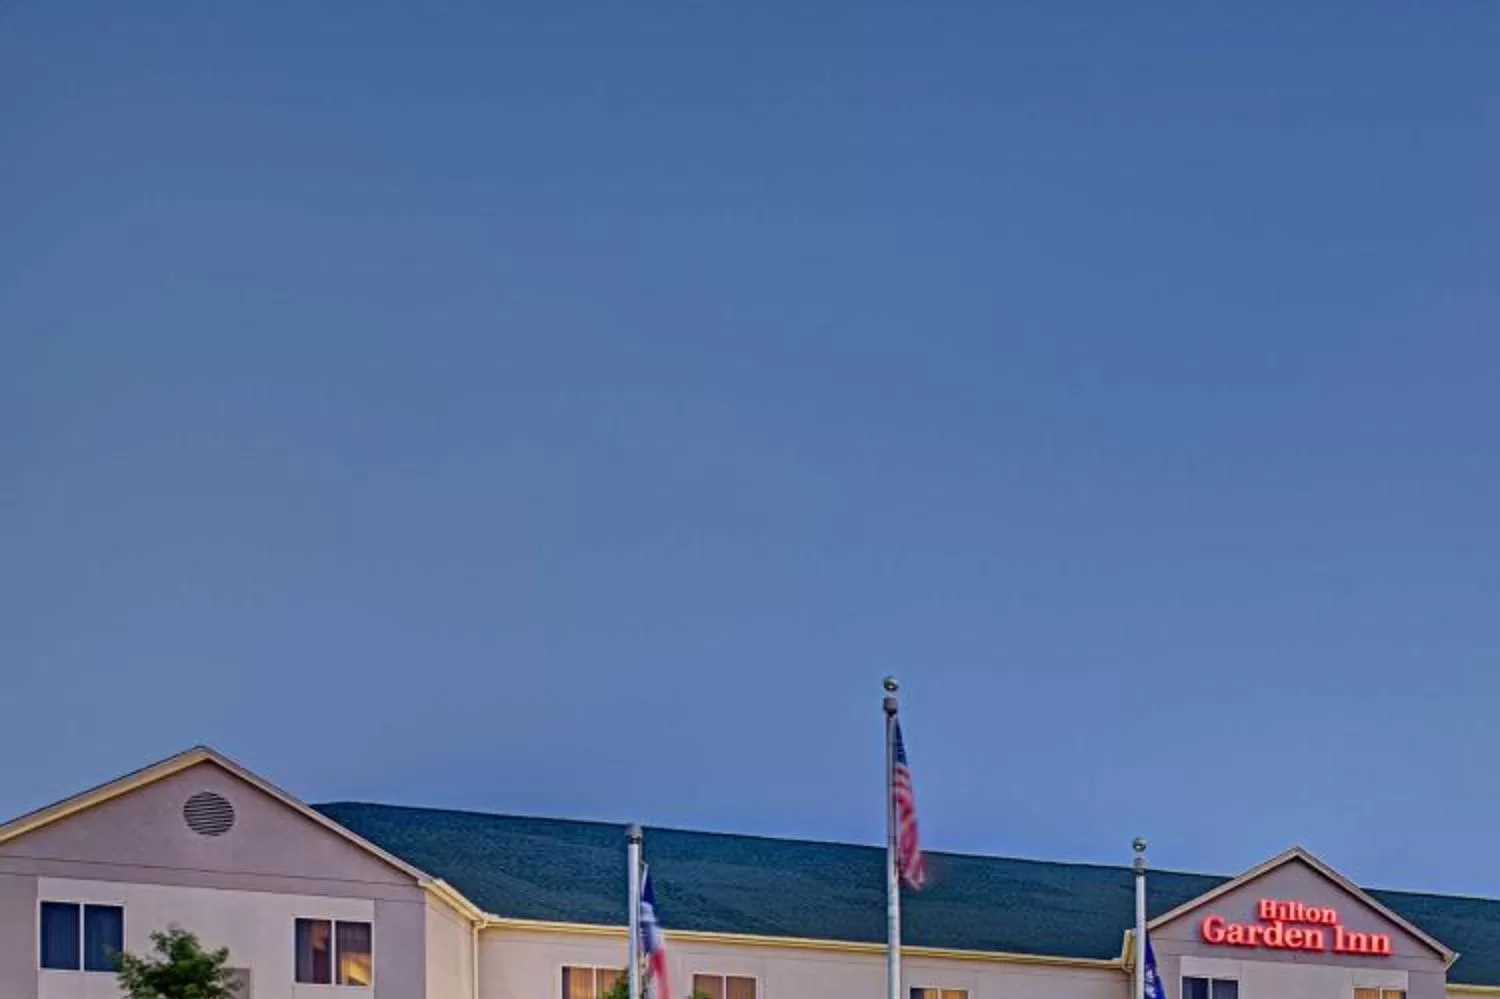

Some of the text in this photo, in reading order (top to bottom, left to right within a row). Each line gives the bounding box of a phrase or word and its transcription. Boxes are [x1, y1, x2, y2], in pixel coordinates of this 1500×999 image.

[1259, 899, 1338, 924] Hilton
[1203, 916, 1393, 955] Garden Inn
